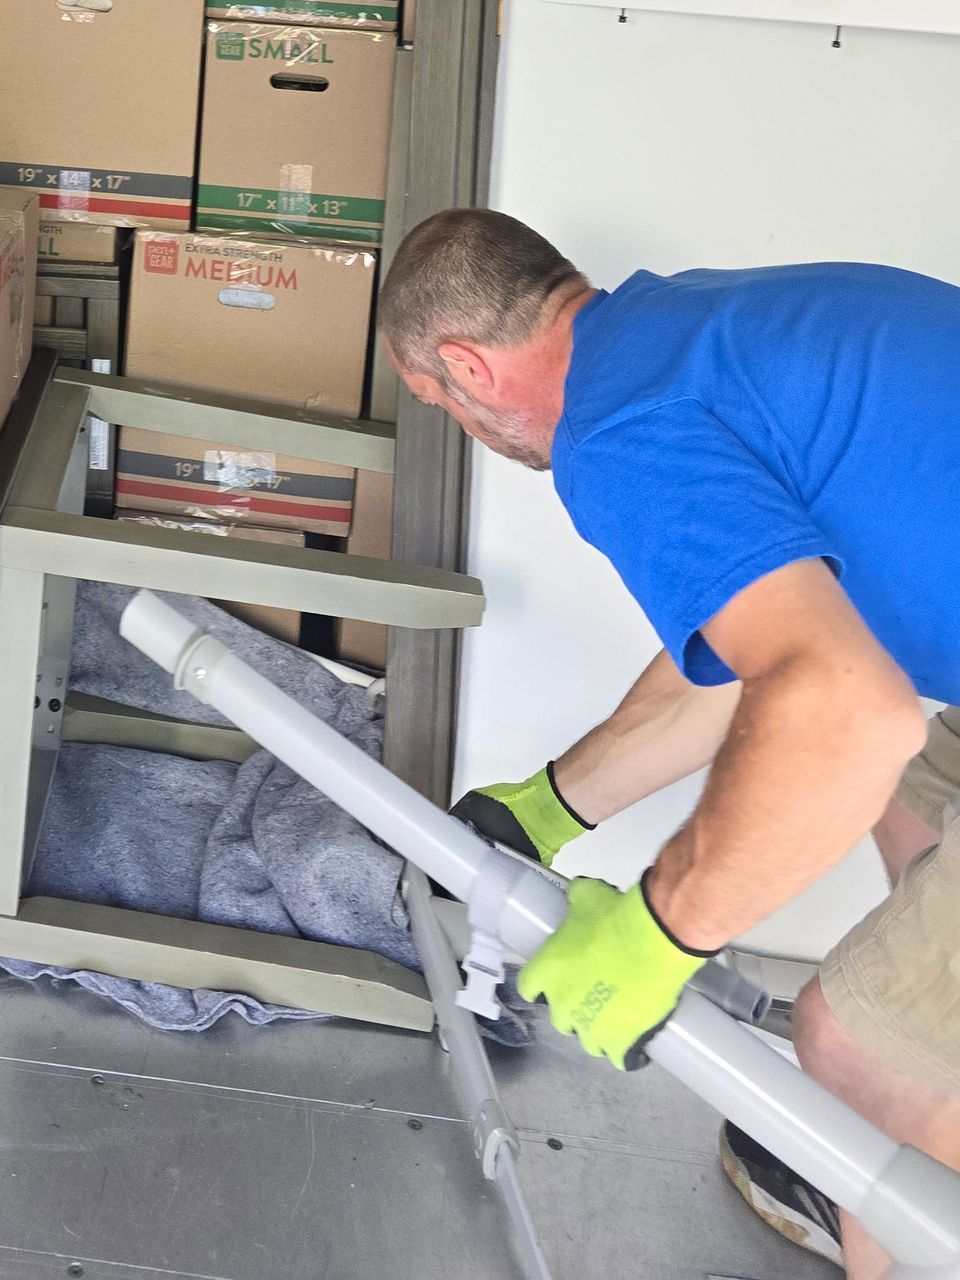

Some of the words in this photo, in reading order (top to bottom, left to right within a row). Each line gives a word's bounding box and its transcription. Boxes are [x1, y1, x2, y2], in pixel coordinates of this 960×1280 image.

[248, 38, 334, 64] SMALL
[17, 167, 43, 182] 19"
[46, 173, 58, 185] x
[92, 177, 102, 188] x
[106, 174, 131, 190] 17"
[237, 192, 263, 207] 17"
[265, 199, 277, 210] x
[307, 202, 318, 213] x
[322, 200, 349, 215] 13"
[148, 245, 176, 257] pen+
[150, 254, 174, 269] GEAR
[185, 244, 221, 256] EXTRA
[222, 247, 283, 263] STRENGTH
[184, 257, 298, 290] MEDIUM
[175, 461, 201, 477] 19"
